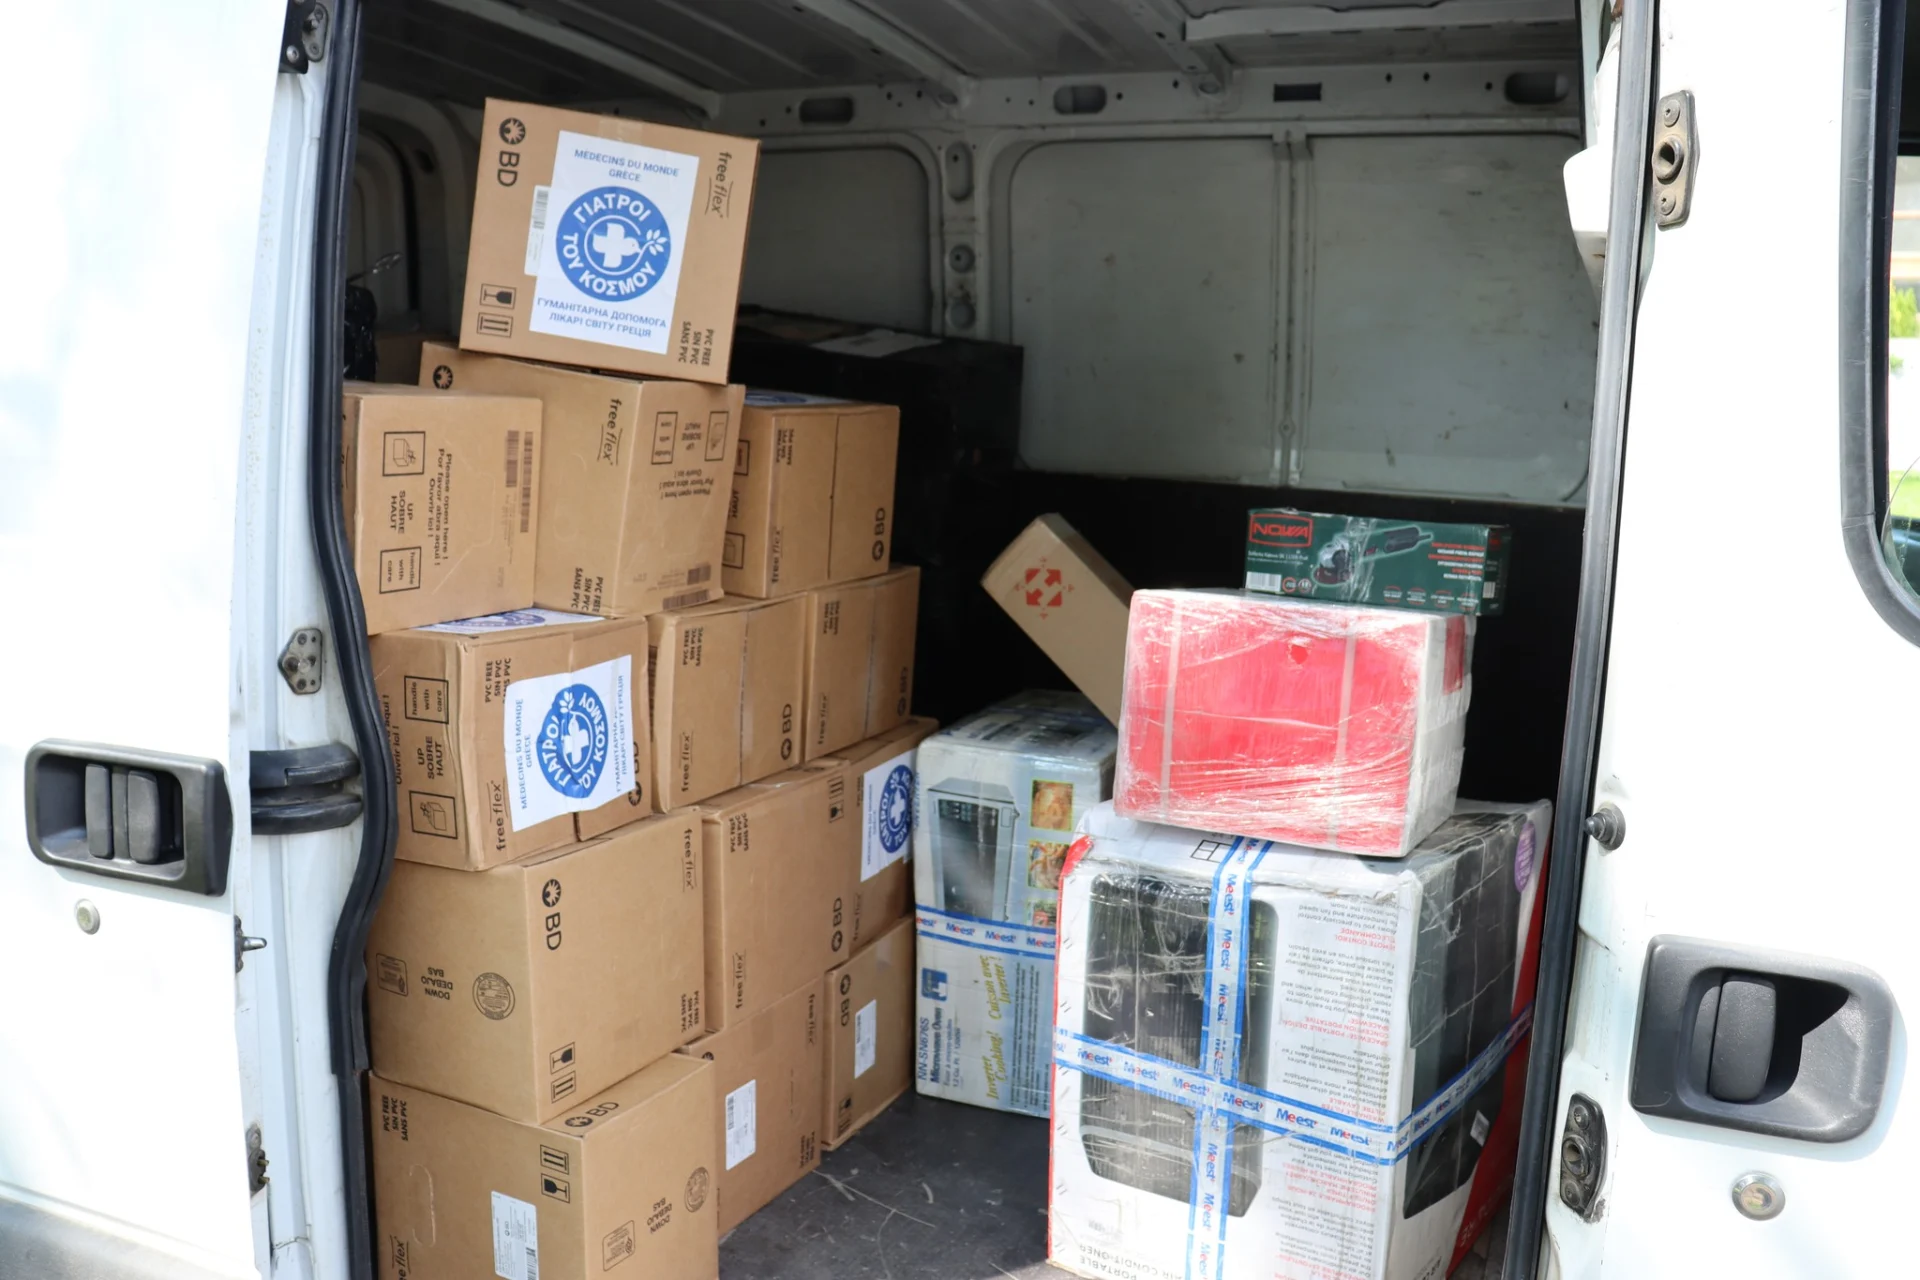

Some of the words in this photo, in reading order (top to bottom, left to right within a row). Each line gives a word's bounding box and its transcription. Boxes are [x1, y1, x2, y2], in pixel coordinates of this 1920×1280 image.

[497, 151, 520, 187] BD
[627, 159, 641, 169] DU
[643, 162, 679, 177] MONDE
[573, 194, 651, 223] ΓΙΑΤΡΟΙ
[562, 232, 584, 270] ΤΟΥ
[579, 261, 656, 296] ΚΟΣΜΟΥ
[537, 297, 609, 318] ГУМАНІТАРНА
[610, 311, 666, 329] ДОПОМОГА
[549, 312, 584, 326] ЛІКАРІ
[584, 319, 614, 332] СВІТУ
[616, 325, 652, 339] ГРЕЦІЯ
[681, 321, 691, 344] SANS
[703, 329, 714, 345] PVC
[692, 331, 702, 346] SIN
[678, 346, 688, 362] PVC
[689, 348, 700, 364] PVC
[701, 348, 712, 366] FREE
[436, 449, 445, 469] Por
[444, 453, 452, 492] Please
[428, 478, 436, 513] Ouvrir
[436, 473, 445, 502] favor
[390, 496, 398, 531] HAUT
[398, 491, 406, 534] SOBRE
[406, 503, 414, 521] UP
[435, 506, 443, 532] abra
[442, 496, 450, 525] open
[874, 507, 886, 536] BD
[442, 528, 451, 553] here
[573, 567, 583, 590] SANS
[584, 578, 593, 593] SIN
[594, 576, 604, 593] PVC
[571, 592, 580, 609] PVC
[581, 594, 591, 612] PVC
[592, 594, 601, 612] FREE
[484, 661, 494, 682] FREE
[494, 659, 502, 678] PVC
[502, 658, 511, 676] PVC
[484, 685, 492, 703] PVC
[493, 681, 501, 697] SIN
[515, 699, 524, 737] MONDE
[782, 703, 792, 734] BD
[417, 748, 425, 766] UP
[515, 738, 523, 753] DU
[425, 736, 434, 779] SOBRE
[434, 741, 444, 777] HAUT
[1222, 872, 1238, 916] Meest
[832, 897, 843, 928] BD
[545, 912, 562, 951] BD
[916, 917, 935, 928] eest
[946, 921, 975, 936] Meest
[985, 930, 1016, 943] Meest
[1220, 928, 1233, 971] Meest
[420, 976, 453, 990] DEBAJO
[427, 967, 445, 978] BAS
[424, 988, 450, 1000] DOWN
[1216, 983, 1229, 1025] Meest
[840, 998, 850, 1027] BD
[931, 1008, 943, 1030] Oven
[930, 1032, 942, 1084] Microwave
[381, 1094, 390, 1114] FREE
[391, 1097, 399, 1115] PVC
[1077, 1048, 1112, 1066] Meest
[1173, 1076, 1210, 1097] Meest
[1222, 1092, 1263, 1112] Meest
[1276, 1107, 1318, 1129] Meest
[1331, 1126, 1372, 1146] Meest
[399, 1100, 408, 1118] PVC
[586, 1102, 619, 1116] BD
[382, 1114, 391, 1132] PVC
[391, 1115, 400, 1131] SIN
[400, 1118, 409, 1142] SANS
[1205, 1142, 1219, 1183] Meest
[646, 1203, 672, 1226] DEBAJO
[652, 1197, 666, 1212] BAS
[1202, 1192, 1216, 1231] Meest
[650, 1214, 671, 1235] DOWN
[1079, 1244, 1158, 1276] CONDITIONER
[1080, 1255, 1137, 1280] PORTABLE
